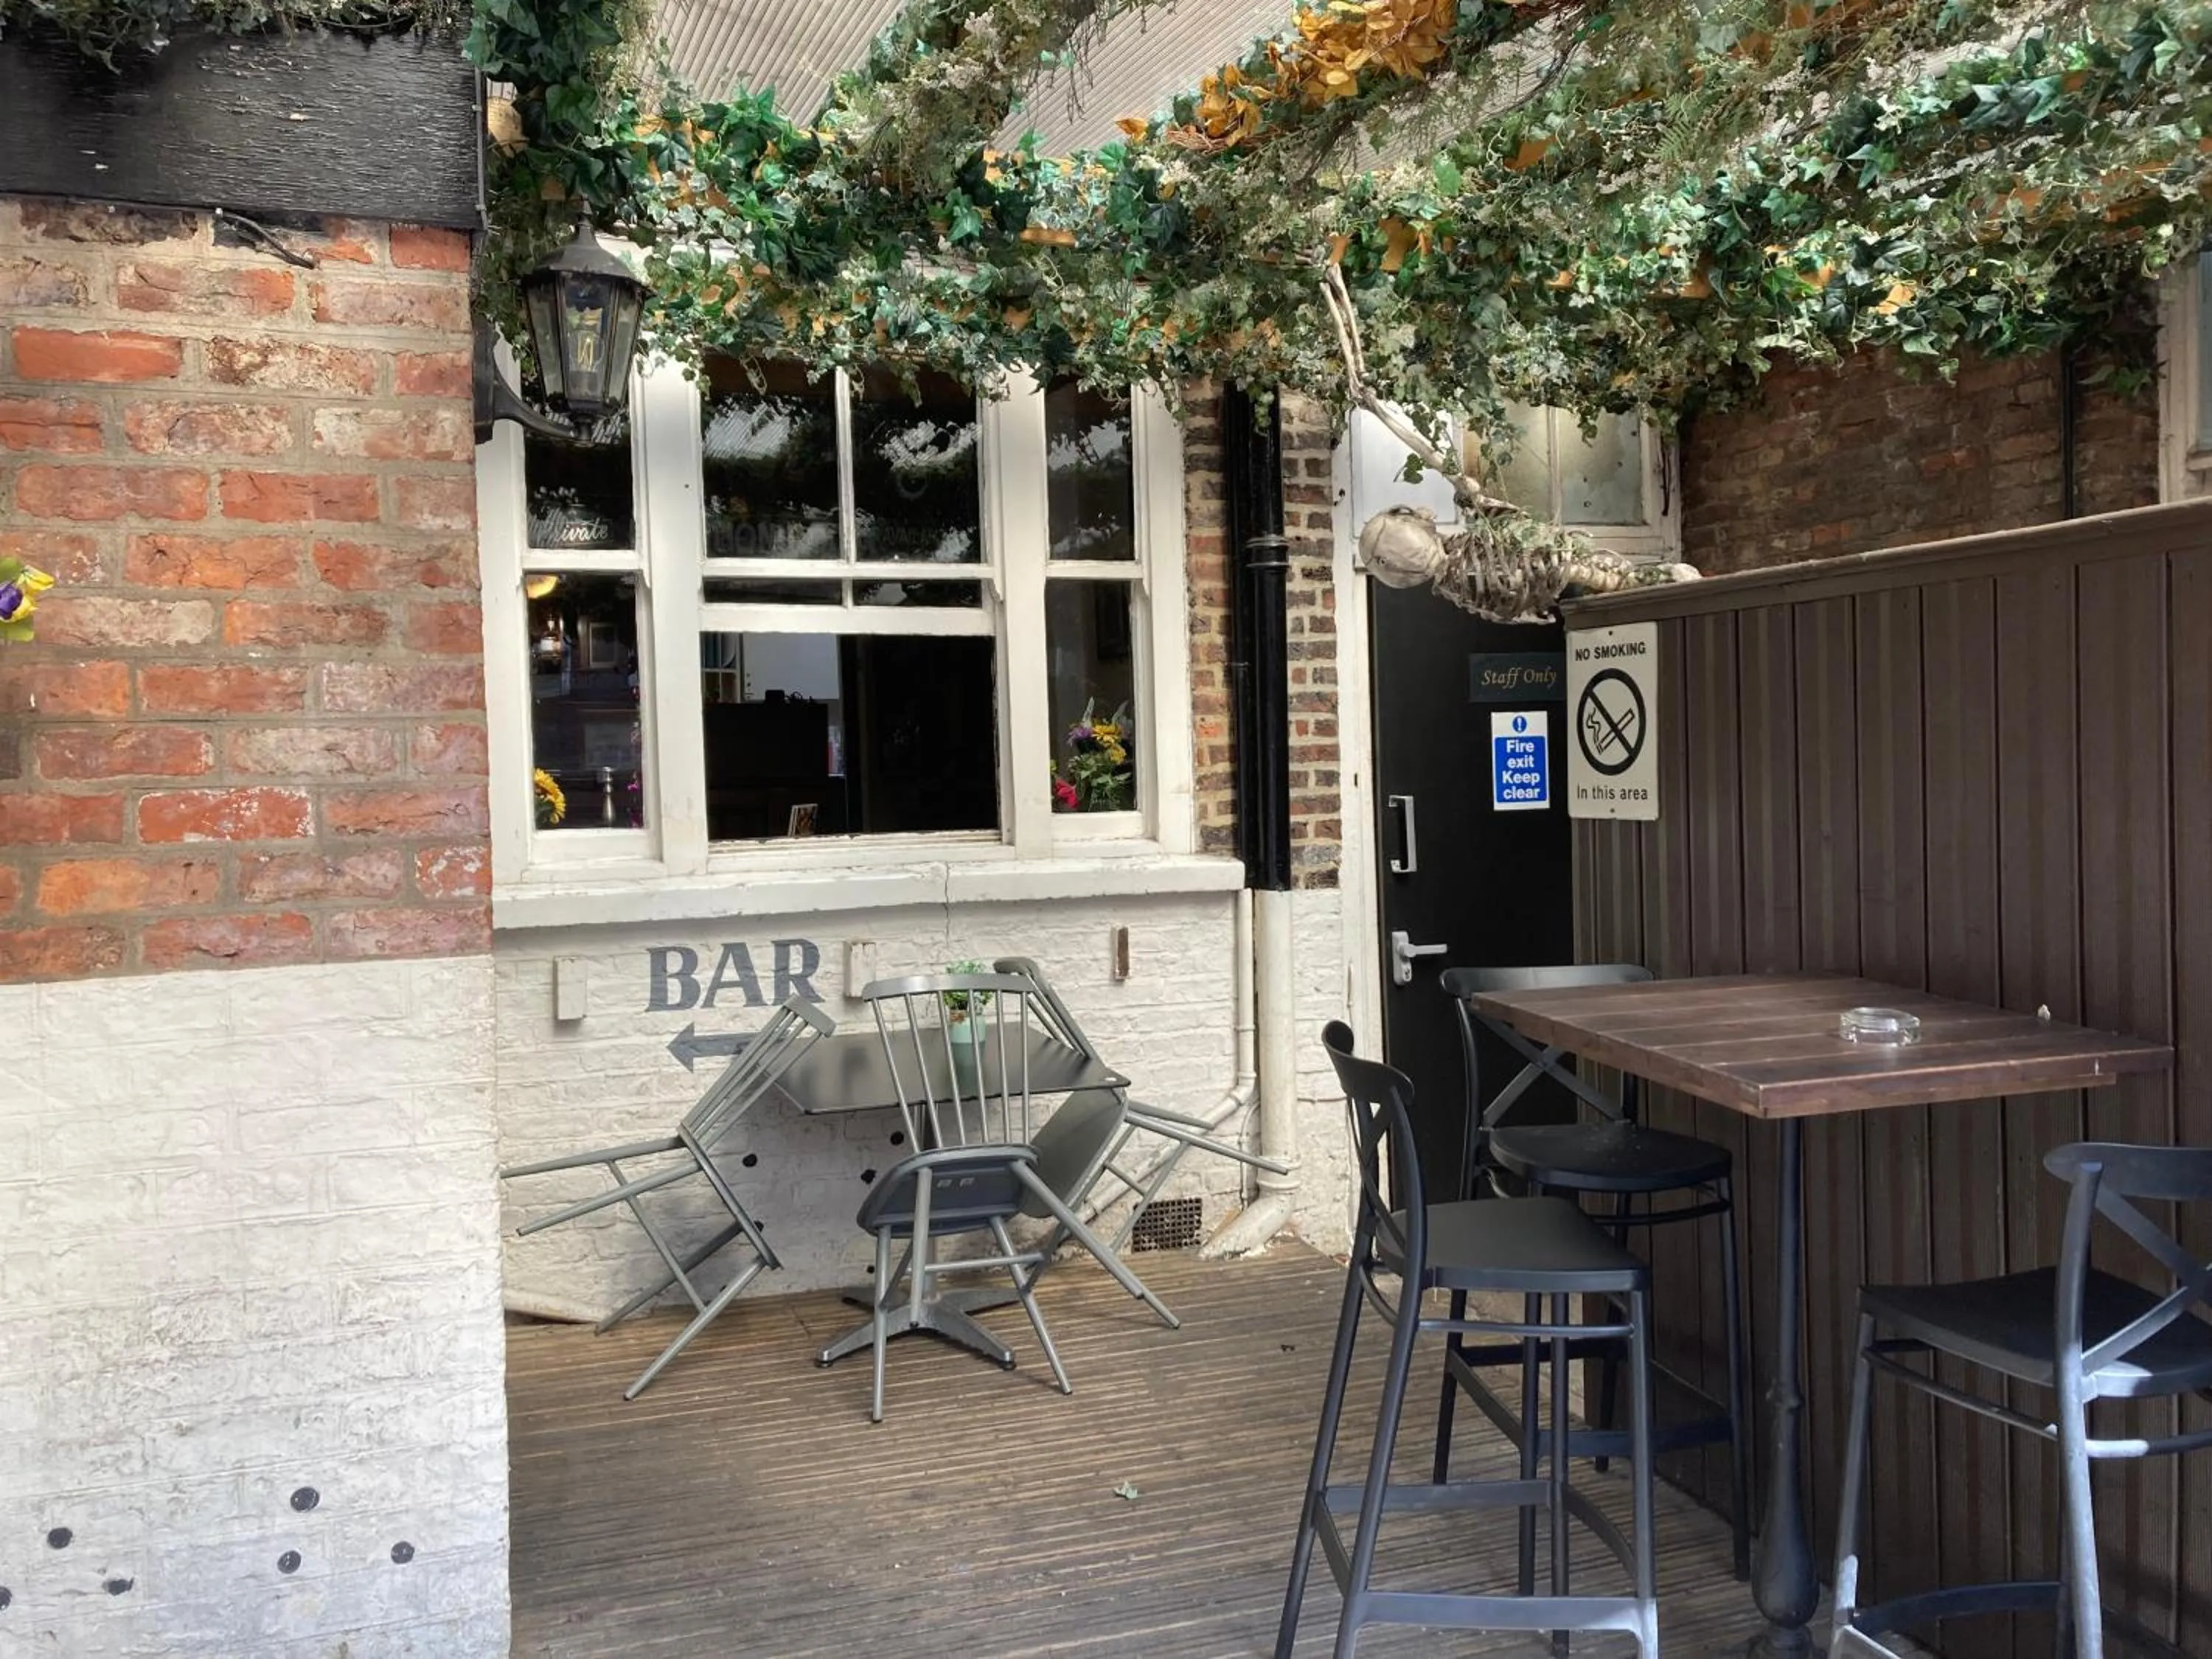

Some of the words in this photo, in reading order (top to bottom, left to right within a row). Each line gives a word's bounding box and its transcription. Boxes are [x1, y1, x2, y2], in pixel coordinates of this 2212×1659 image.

[1575, 647, 1590, 661] NO
[1593, 641, 1646, 660] SMOKING
[1481, 667, 1522, 689] Staff
[1523, 665, 1557, 690] Only
[1506, 740, 1534, 753] Fire
[1506, 755, 1534, 768] exit
[1502, 771, 1540, 785] Keep
[1503, 786, 1540, 799] clear
[1576, 785, 1587, 799] In
[1591, 785, 1615, 800] this
[1619, 788, 1649, 801] area
[644, 939, 825, 1012] BAR
